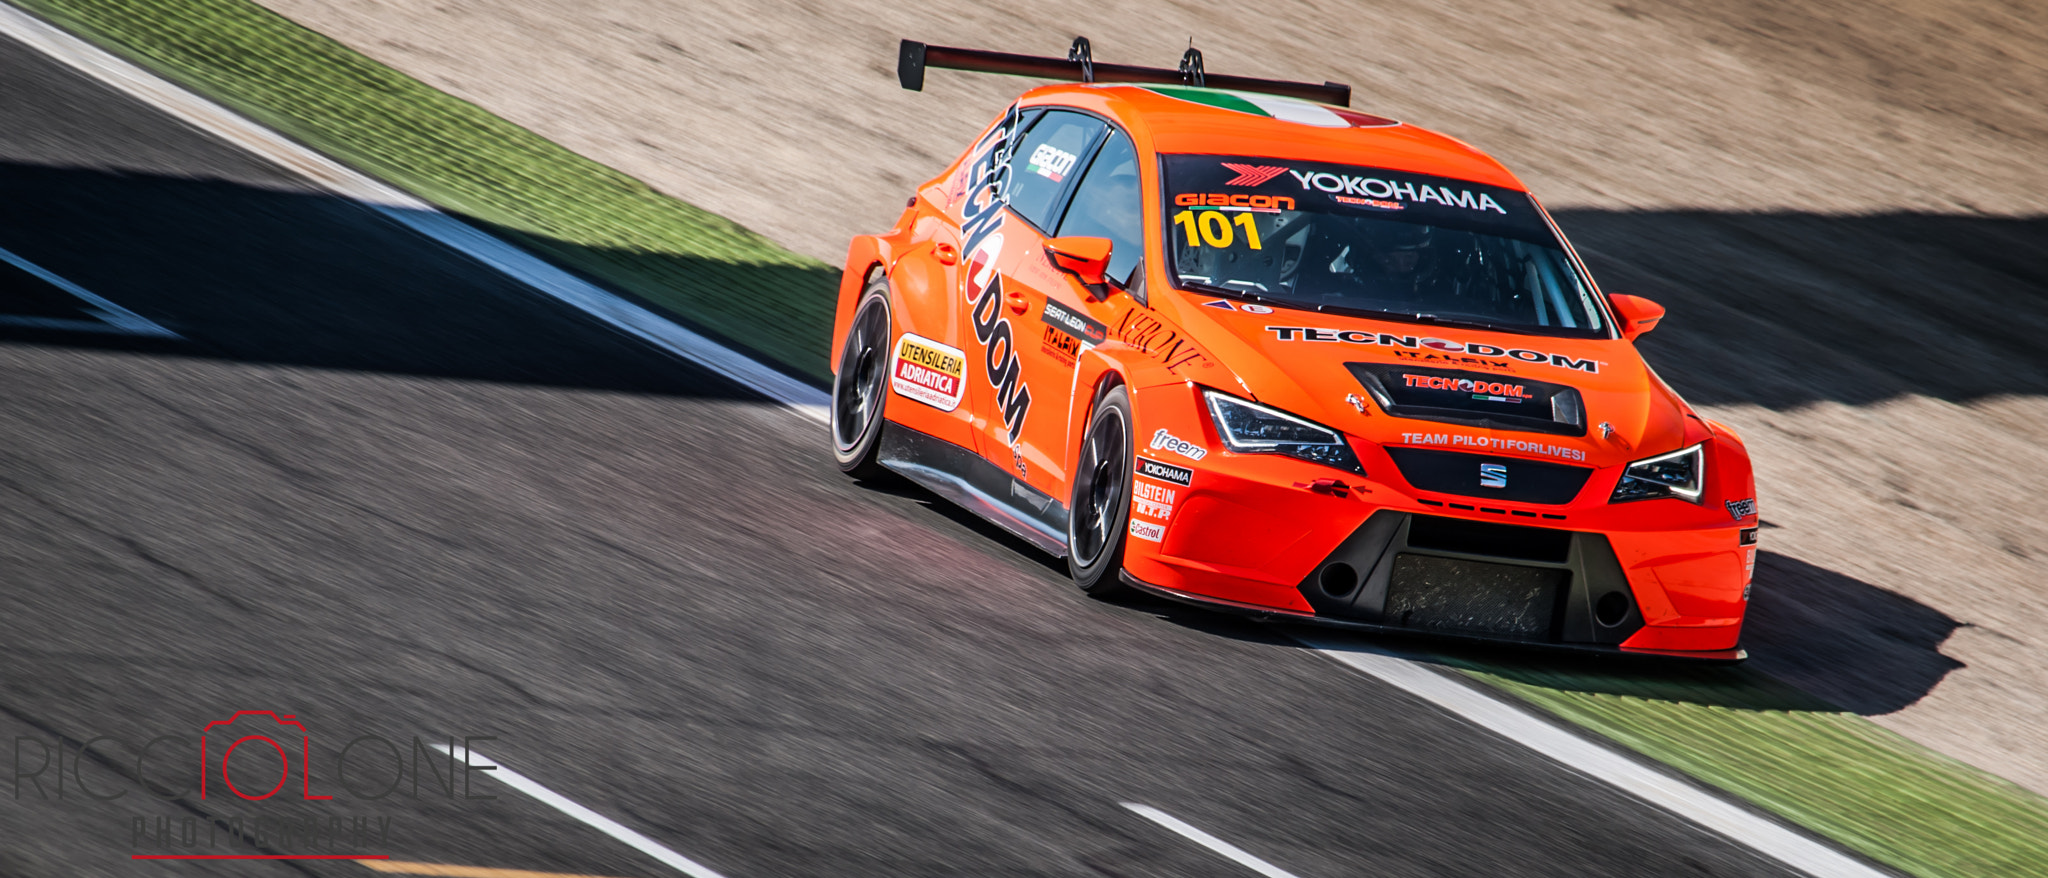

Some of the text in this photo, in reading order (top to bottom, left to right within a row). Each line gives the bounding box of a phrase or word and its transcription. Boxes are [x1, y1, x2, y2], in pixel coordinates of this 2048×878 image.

[1289, 169, 1507, 215] YOKOHAMA
[1173, 209, 1262, 250] 101
[1108, 307, 1208, 376] NERONE
[1265, 326, 1600, 374] TECNODOM
[901, 341, 962, 376] UTENSILERIA
[900, 362, 954, 394] ADRIATICA
[1150, 429, 1206, 461] freem
[1402, 433, 1448, 445] TEAM
[1144, 462, 1189, 483] YOKOHAMA
[1133, 480, 1176, 505] BILSTEIN
[1725, 498, 1757, 521] freem
[1135, 523, 1161, 539] Castrol
